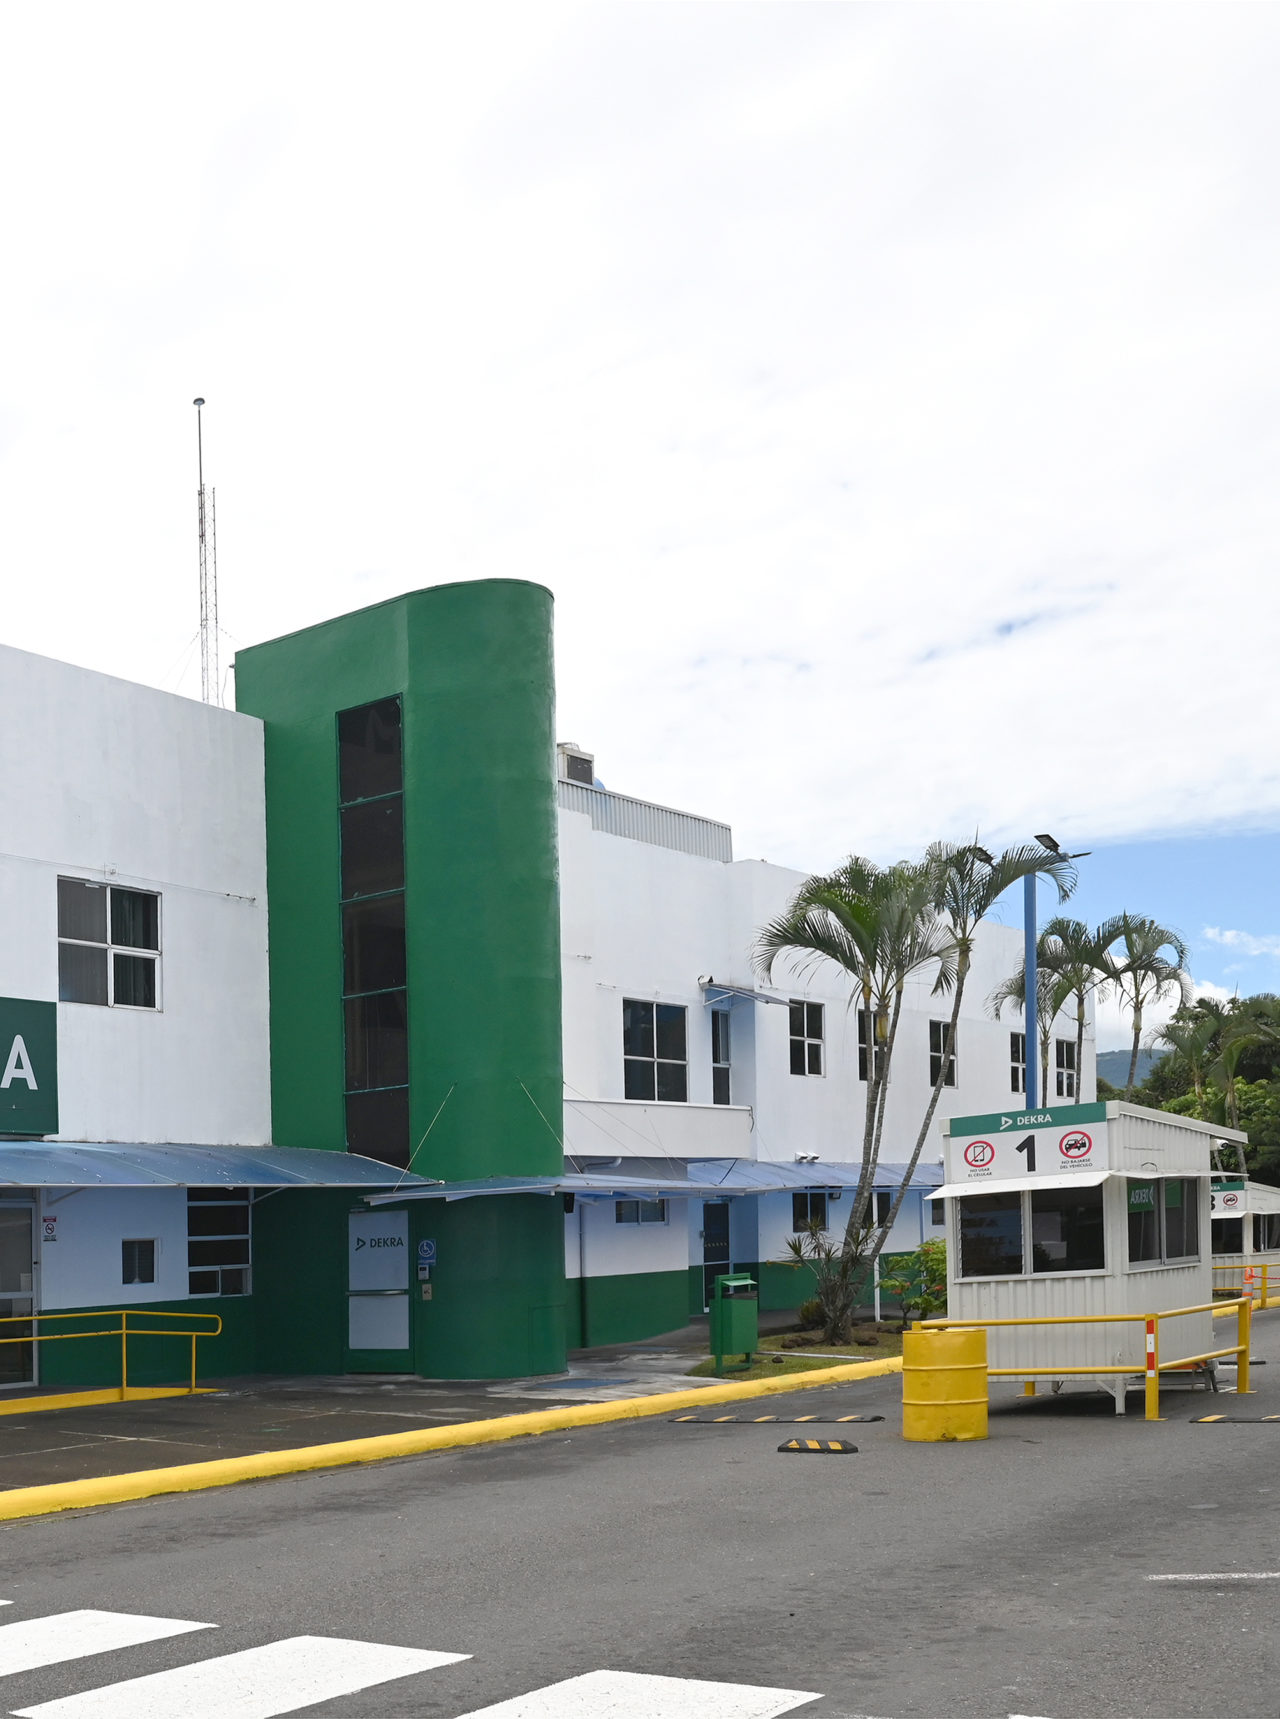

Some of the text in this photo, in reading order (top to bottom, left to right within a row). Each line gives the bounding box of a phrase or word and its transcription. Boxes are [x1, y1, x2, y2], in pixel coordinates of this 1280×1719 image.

[1017, 1113, 1053, 1126] DEKRA
[1015, 1134, 1036, 1172] 1
[370, 1236, 404, 1248] DEKRA
